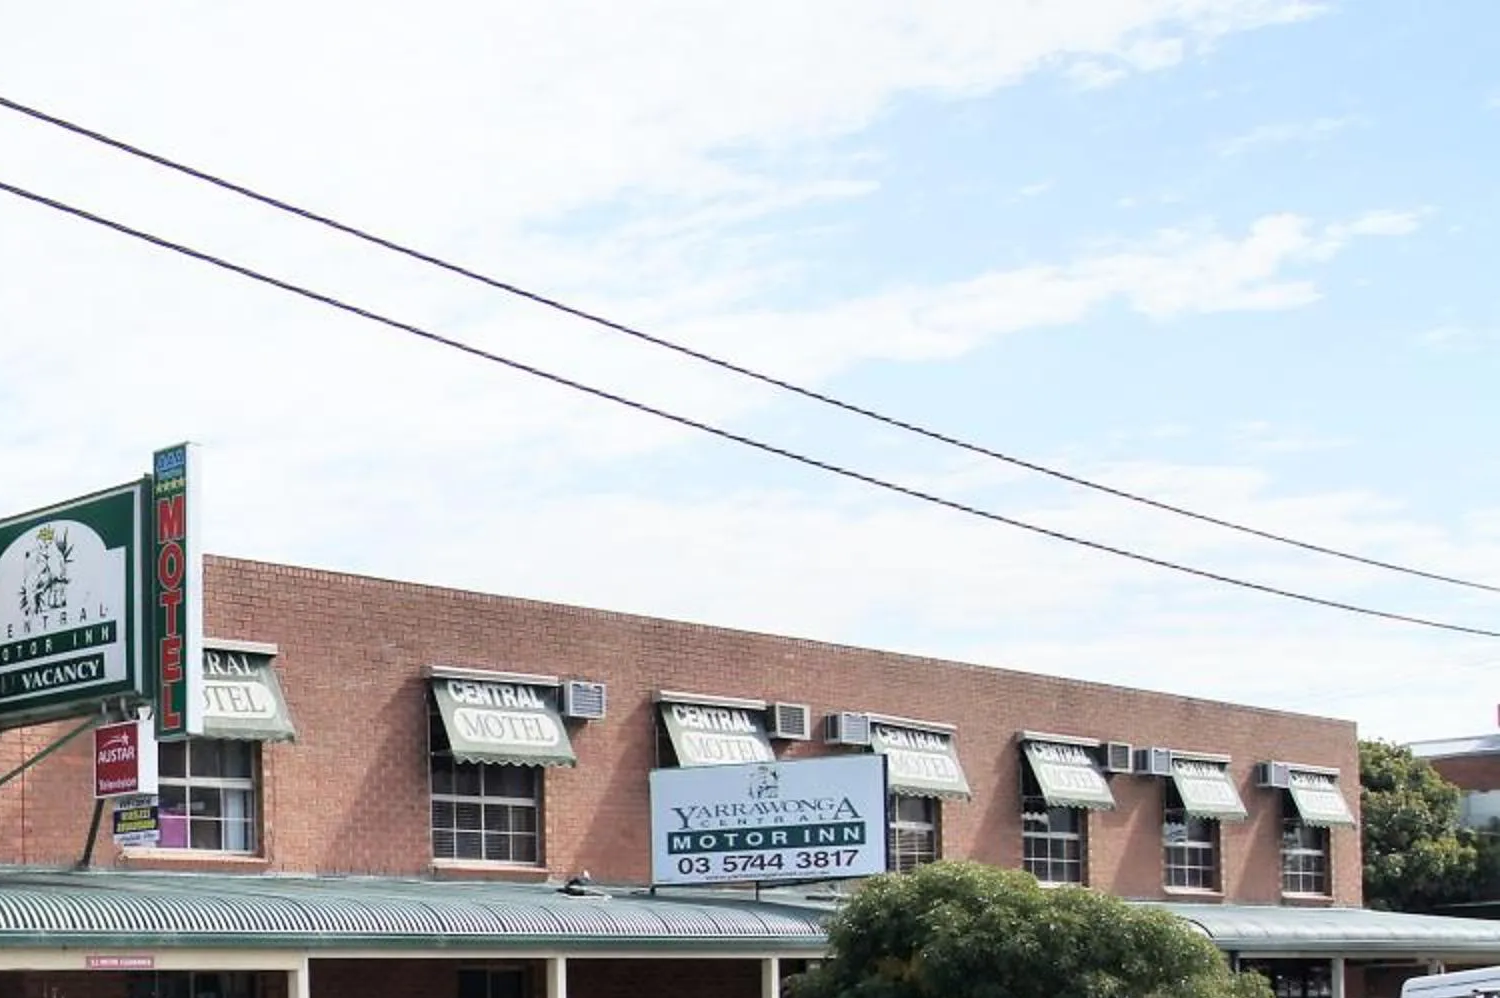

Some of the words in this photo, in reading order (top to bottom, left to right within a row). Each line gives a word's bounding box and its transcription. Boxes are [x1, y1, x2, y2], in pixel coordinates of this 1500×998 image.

[158, 495, 186, 731] MOTEL
[73, 625, 109, 646] INN
[21, 659, 100, 690] VACANCY
[203, 685, 266, 712] TEL
[448, 680, 545, 709] CENTRAL
[460, 712, 554, 742] MOTEL
[672, 705, 757, 732] CENTRAL
[98, 745, 135, 764] AUSTAR
[671, 796, 863, 831] YARRAWONGA
[701, 814, 825, 828] CENTRAL
[673, 831, 787, 850] MOTOR
[804, 825, 860, 844] INN
[677, 857, 711, 875] 03
[723, 853, 784, 872] 5744
[796, 849, 859, 869] 3817
